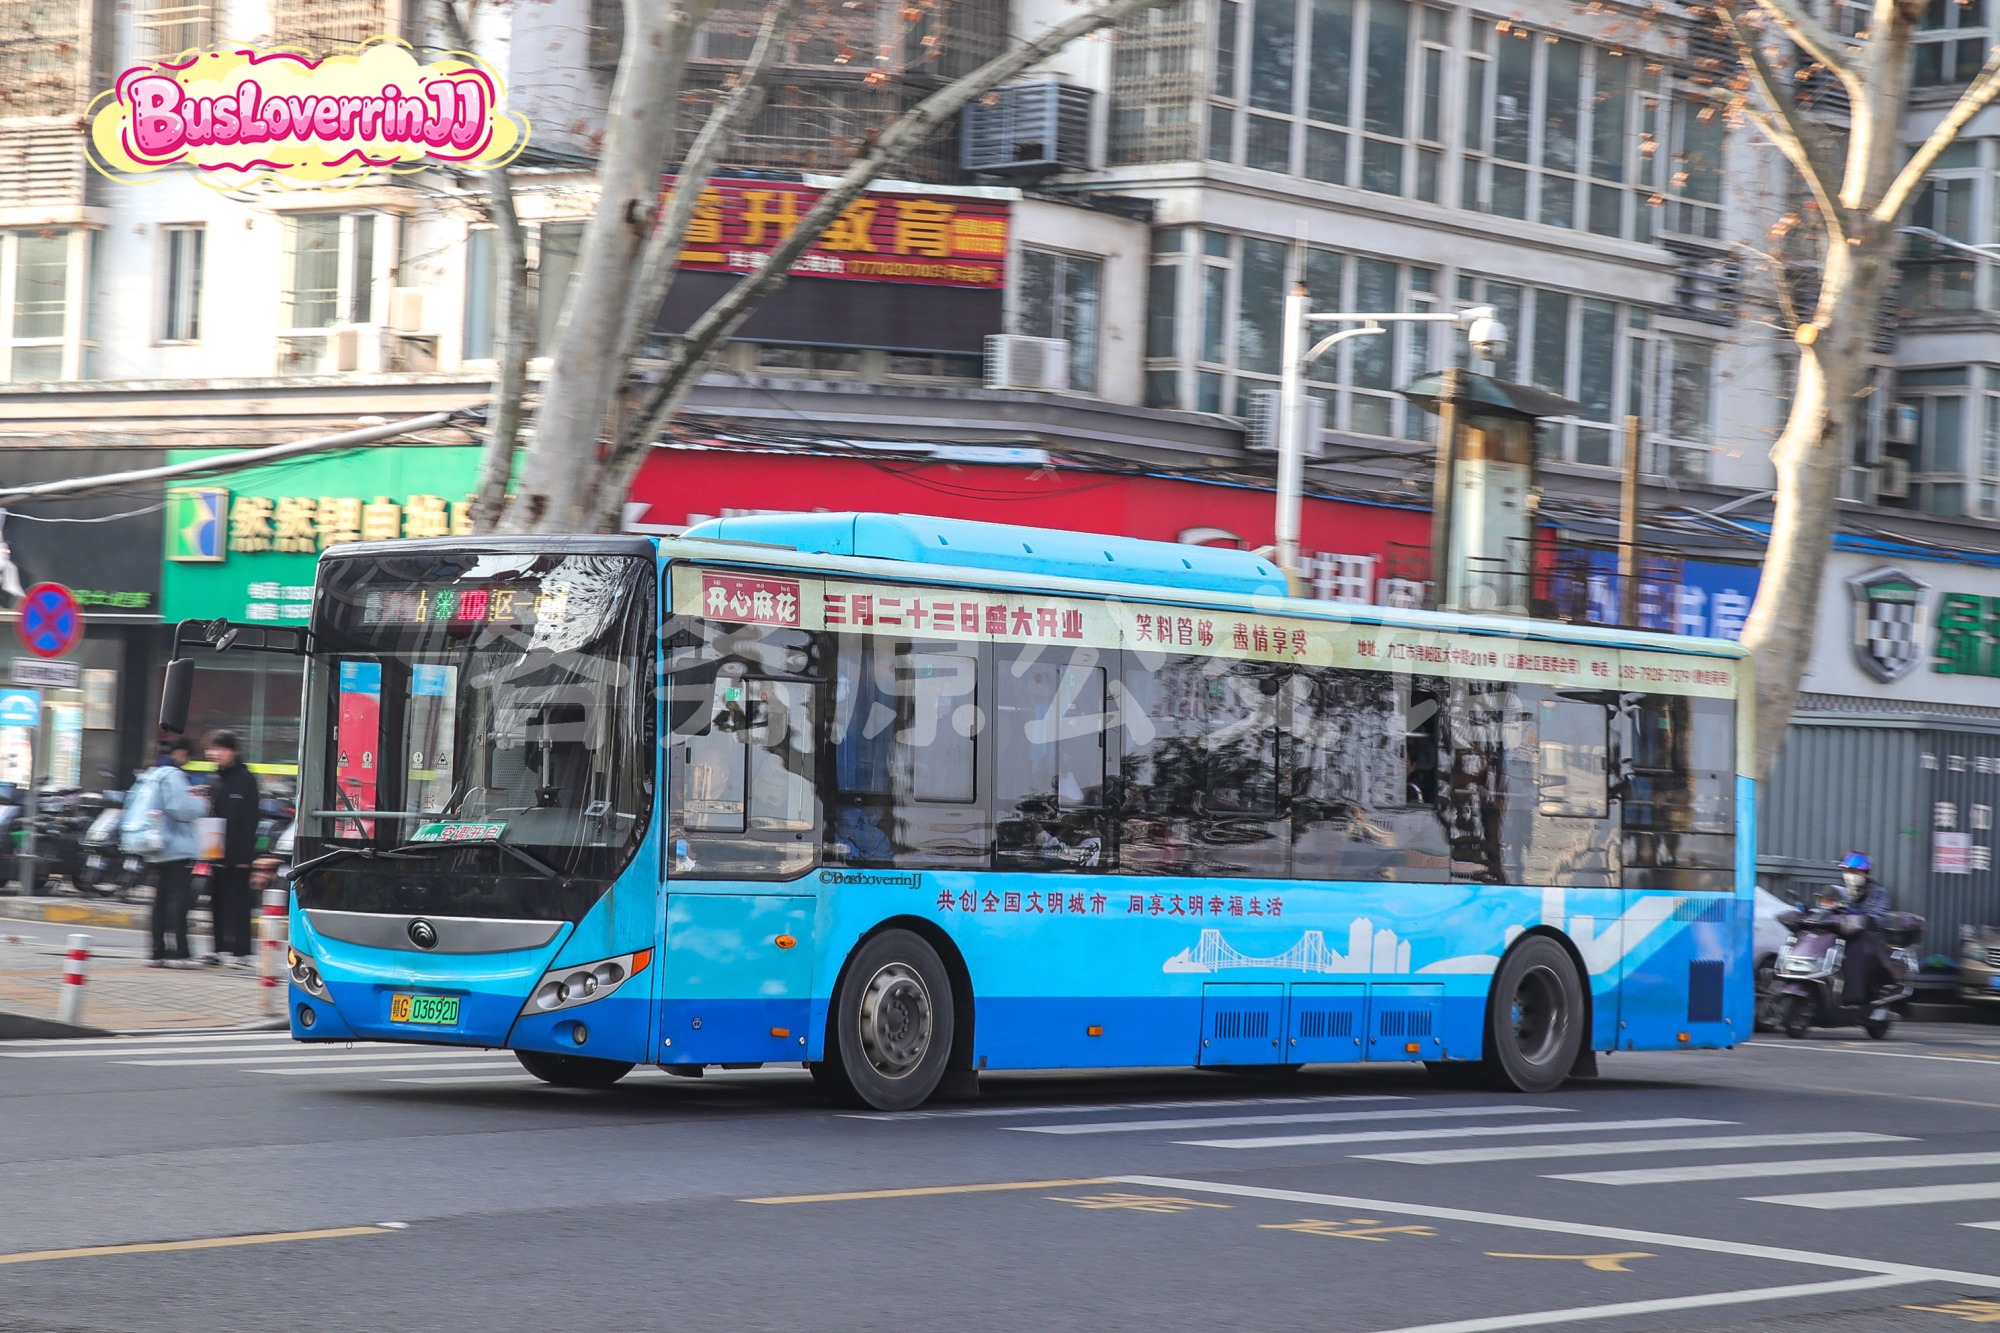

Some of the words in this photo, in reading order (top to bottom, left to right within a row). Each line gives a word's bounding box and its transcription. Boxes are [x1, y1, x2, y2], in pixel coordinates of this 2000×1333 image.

[707, 586, 797, 622] 开心麻花
[824, 593, 1084, 639] 三月二十三日盛大开业
[1136, 613, 1214, 647] 笑料管够
[936, 889, 1107, 916] 共创全国文明城市
[1127, 893, 1284, 917] 同享文明幸福生活
[412, 999, 458, 1021] 03692D
